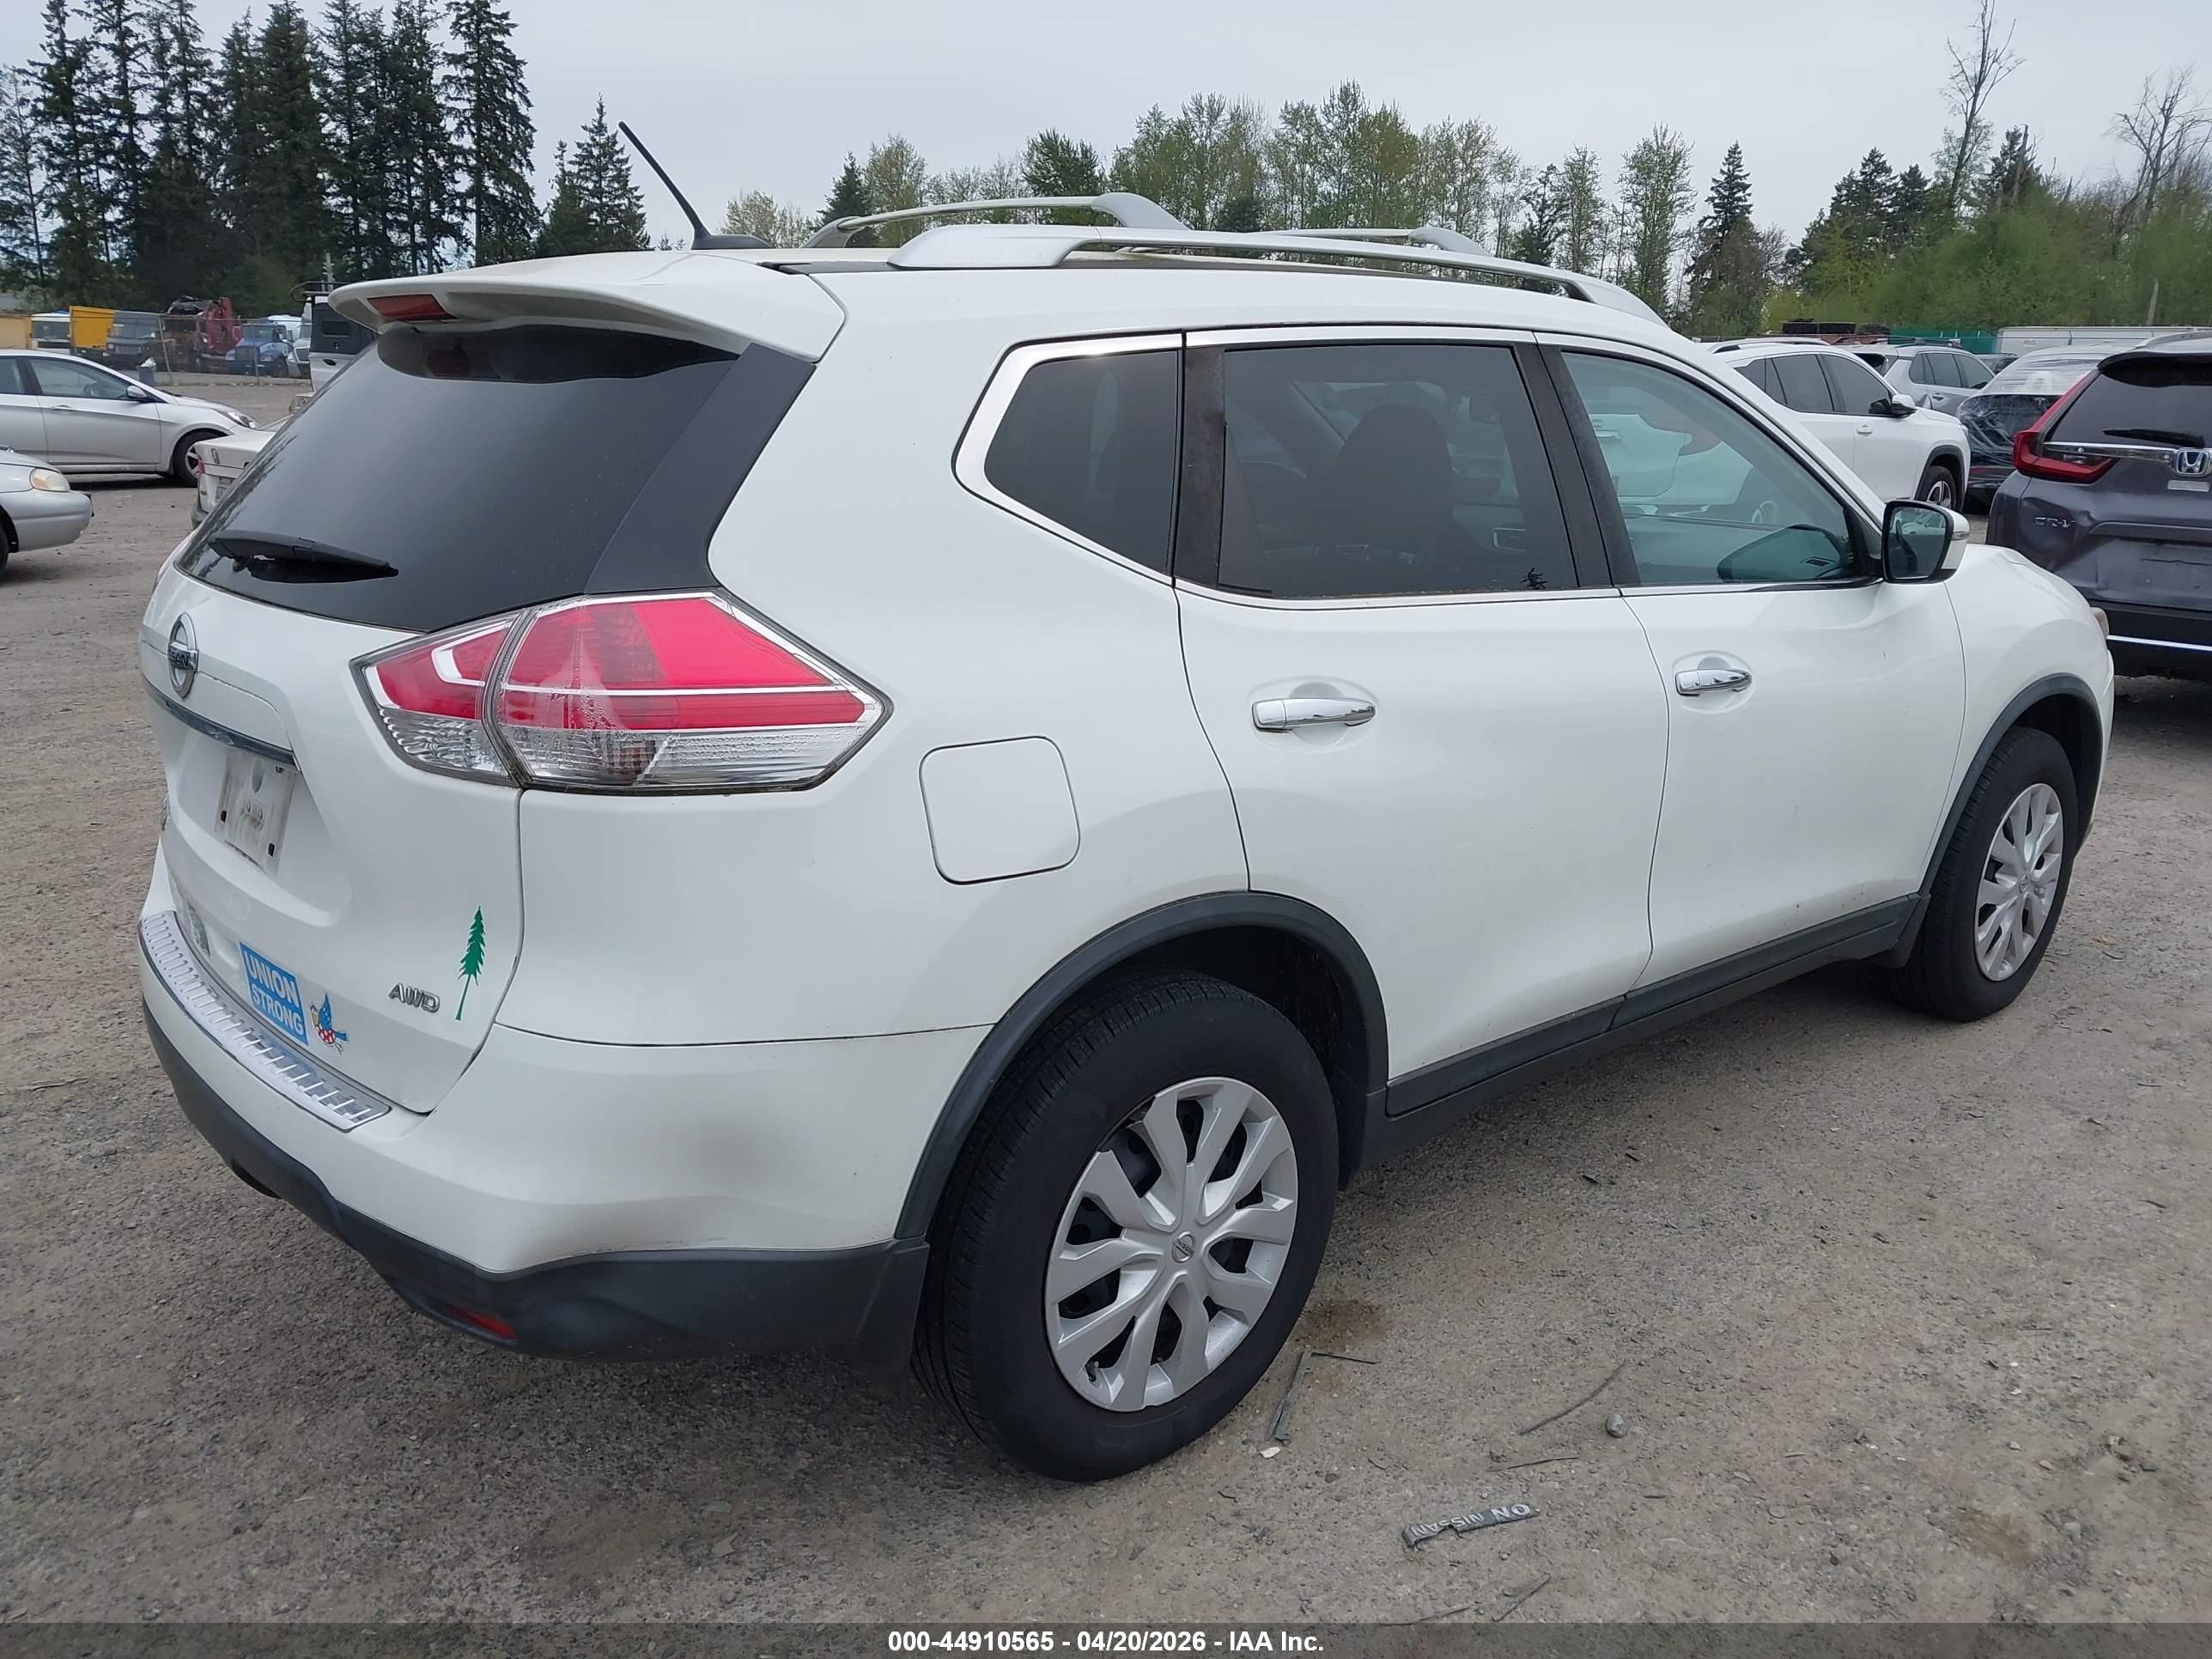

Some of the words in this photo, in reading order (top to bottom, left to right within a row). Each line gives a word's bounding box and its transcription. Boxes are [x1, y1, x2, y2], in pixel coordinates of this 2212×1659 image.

[246, 951, 299, 1008] UNION
[388, 982, 441, 1014] AWD
[252, 983, 305, 1036] STRONG
